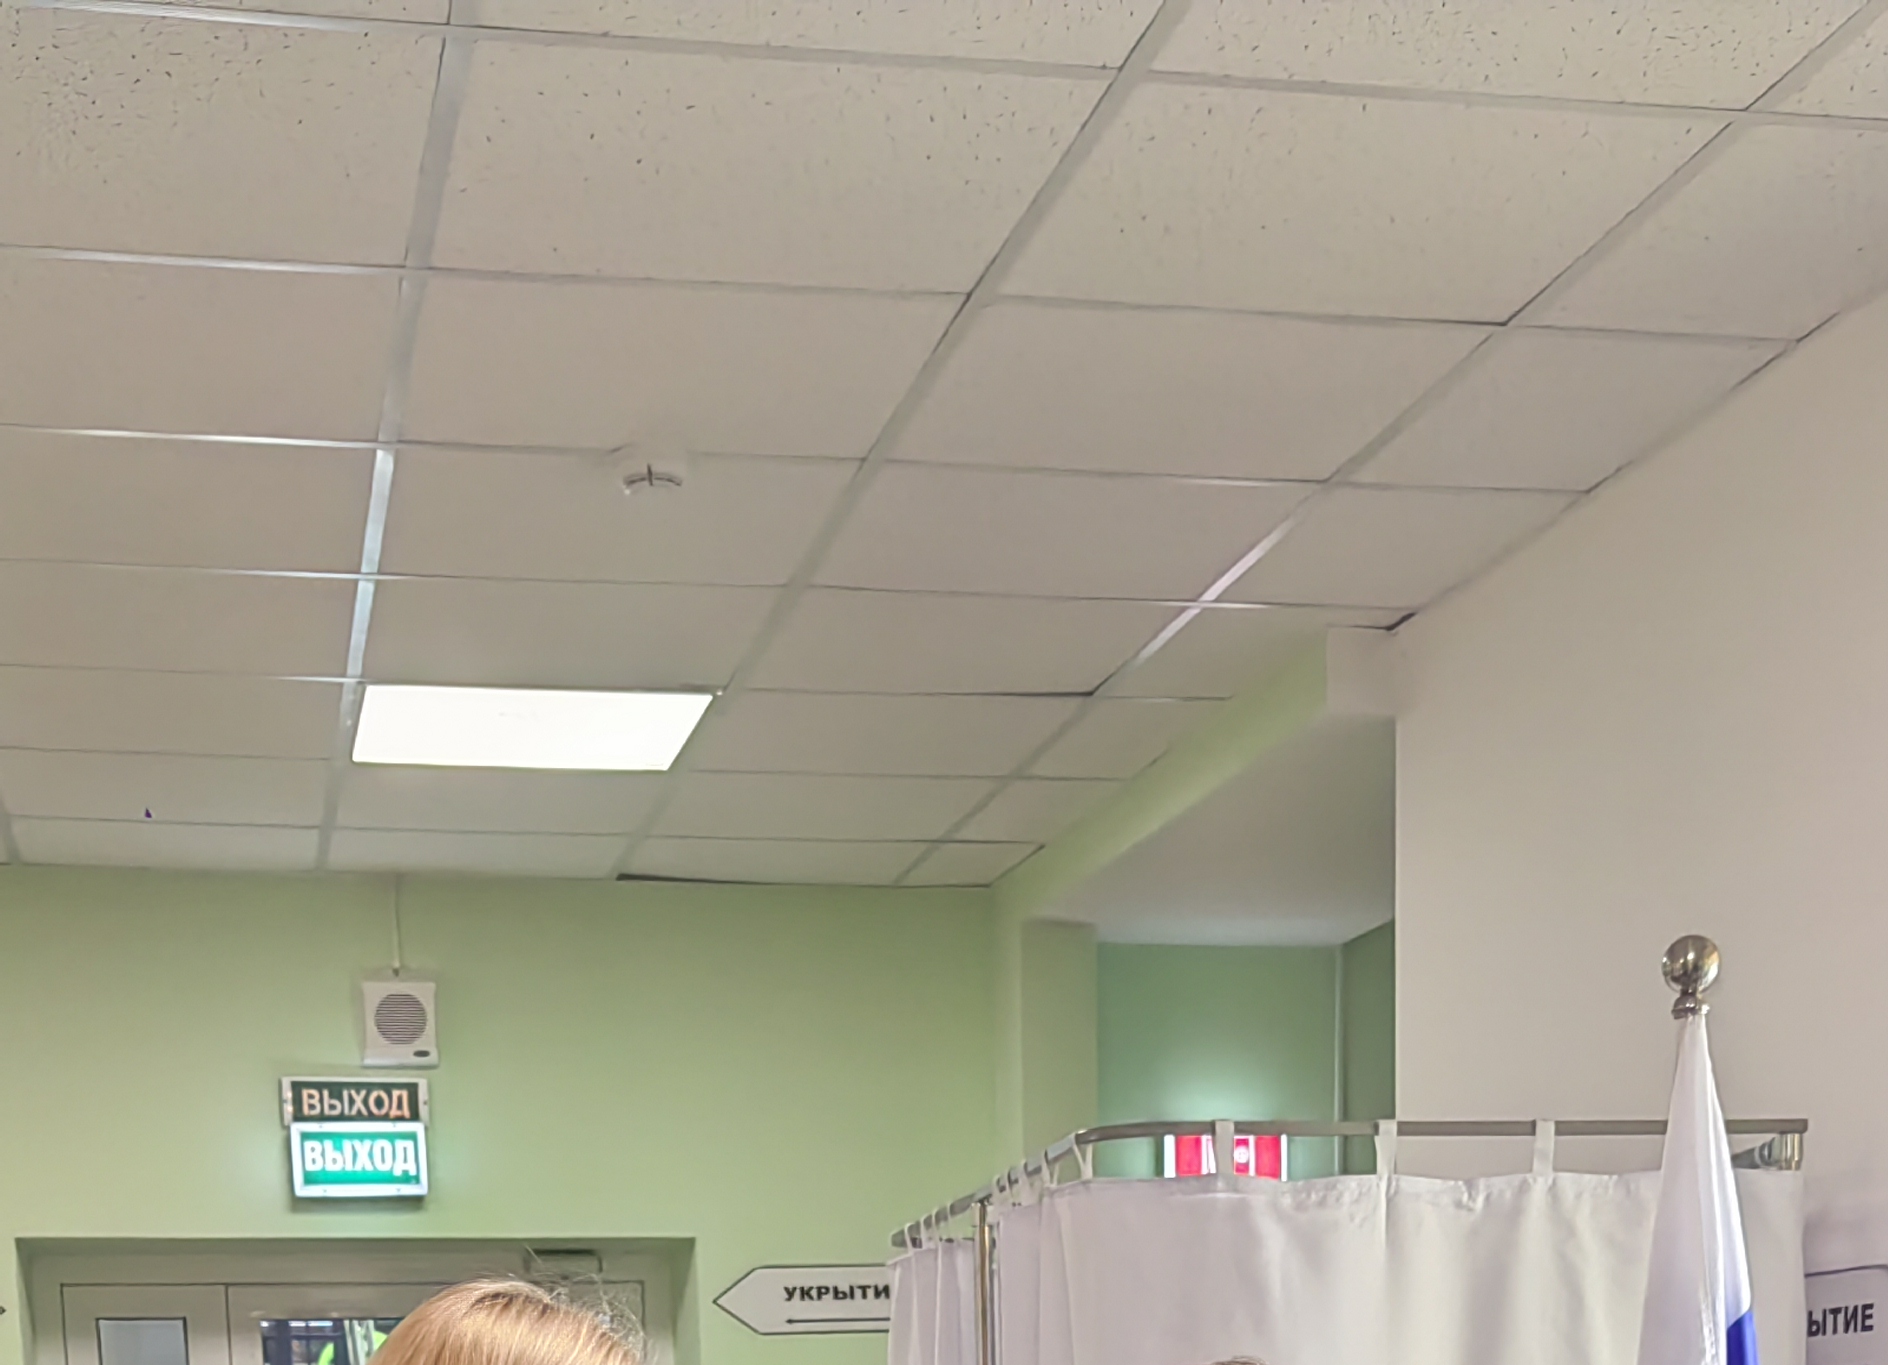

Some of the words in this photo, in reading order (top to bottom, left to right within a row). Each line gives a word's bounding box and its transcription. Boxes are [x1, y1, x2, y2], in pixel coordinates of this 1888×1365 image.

[301, 1088, 411, 1118] ВЫХОД
[303, 1138, 418, 1177] ВЫХОД
[783, 1284, 891, 1301] УКРЫТИ
[1807, 1303, 1874, 1337] ЫТИЕ
